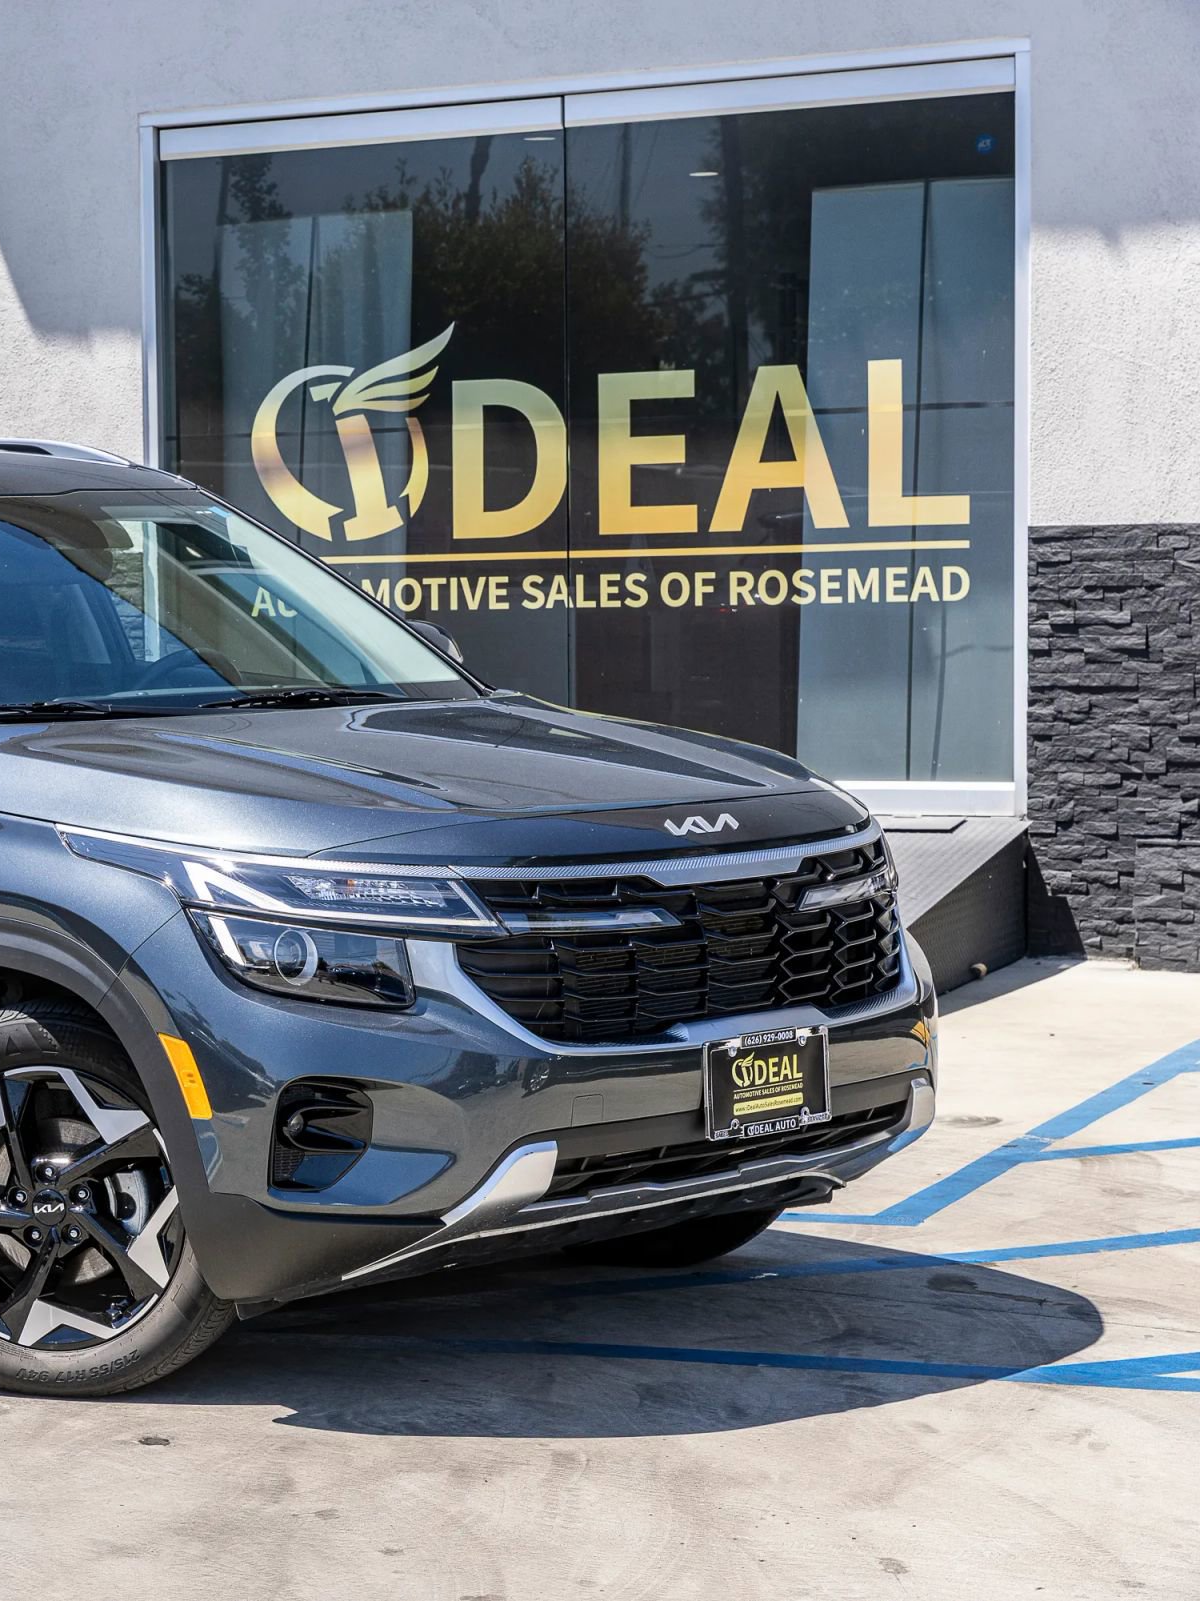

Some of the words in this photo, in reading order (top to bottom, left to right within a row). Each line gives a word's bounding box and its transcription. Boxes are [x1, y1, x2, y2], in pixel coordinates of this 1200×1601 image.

[251, 573, 510, 619] AMOTIVE
[520, 568, 646, 611] SALES
[657, 569, 715, 608] OF
[735, 563, 972, 608] ROSEMEAD
[744, 1035, 762, 1047] (626)
[733, 1090, 762, 1100] AUTOMOTIVE
[762, 1087, 775, 1095] SALES
[781, 1082, 804, 1092] ROSEMEAD
[775, 1118, 797, 1131] AUTO
[89, 1349, 140, 1379] 215/55
[16, 1367, 49, 1382] 94V
[56, 1370, 87, 1382] R17
